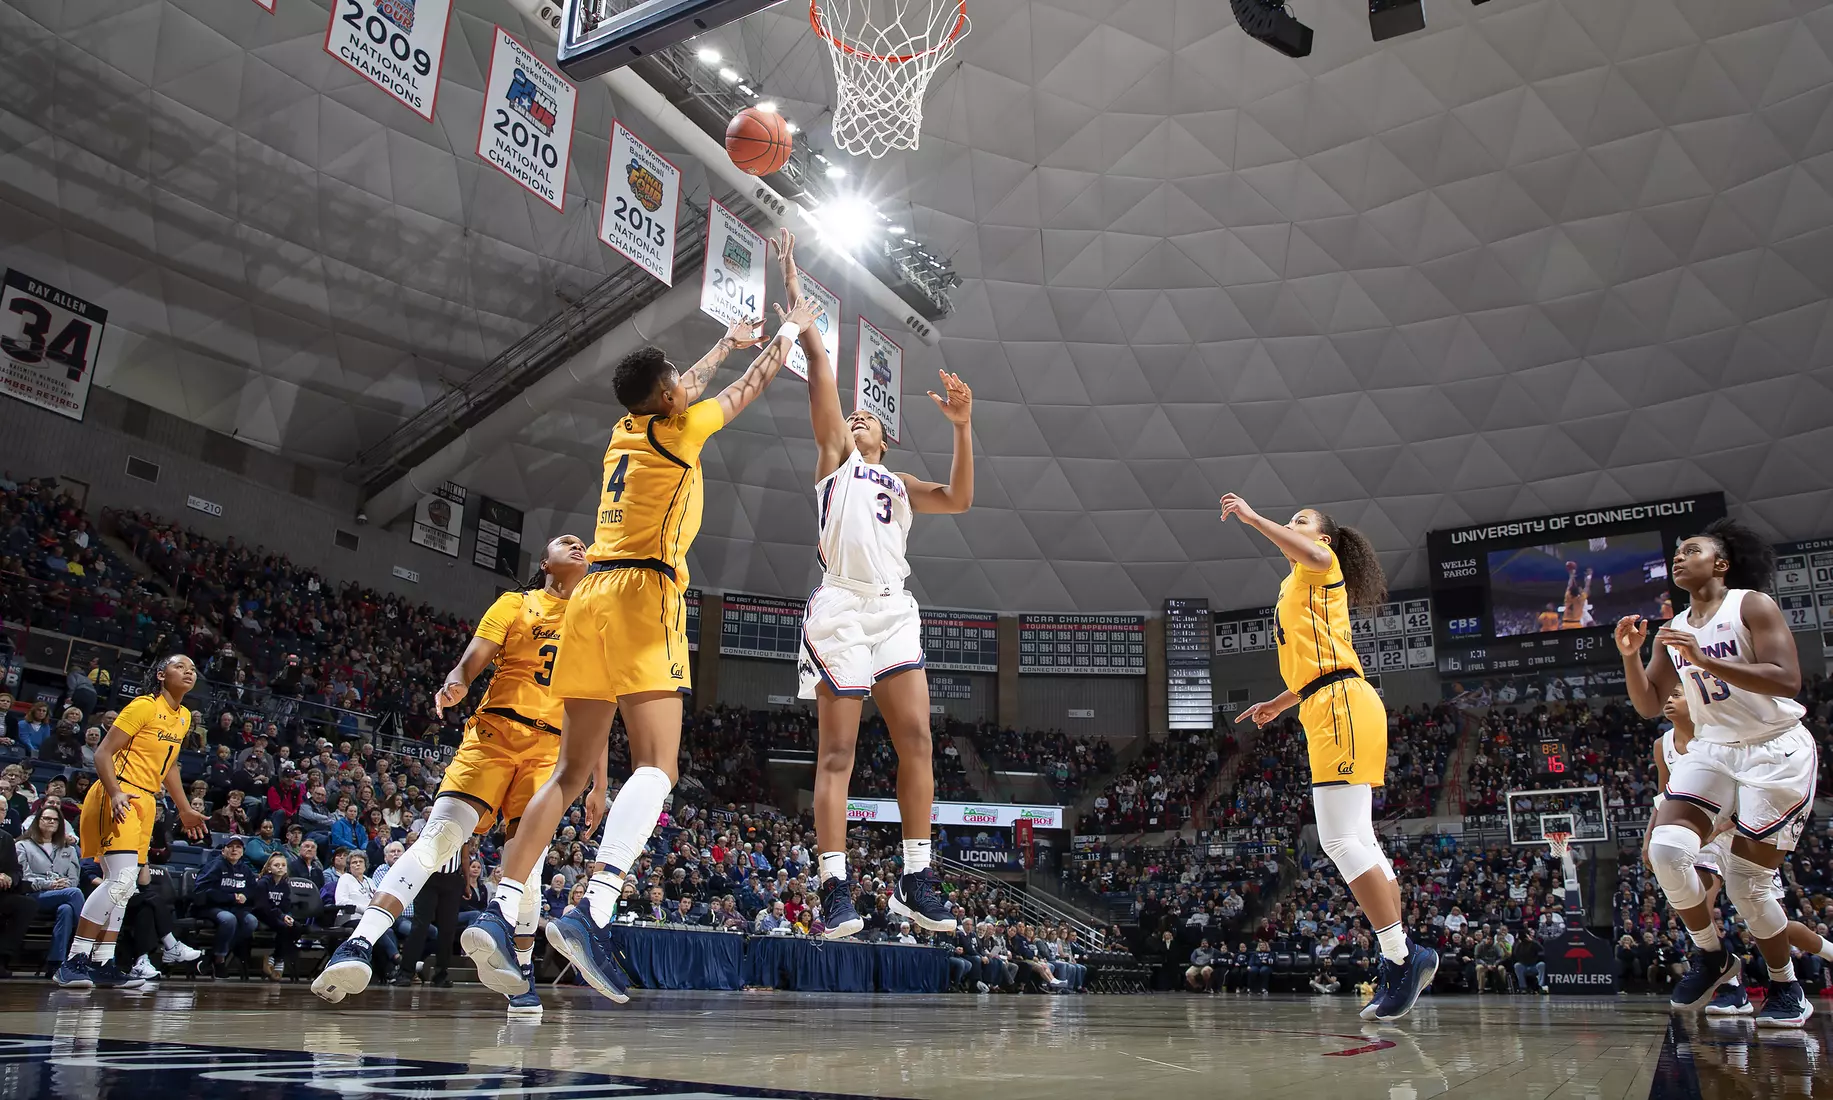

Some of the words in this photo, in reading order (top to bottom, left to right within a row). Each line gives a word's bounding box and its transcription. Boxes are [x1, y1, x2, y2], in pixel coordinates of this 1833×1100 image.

[342, 0, 431, 76] 2009
[349, 33, 418, 90] NATIONAL
[504, 35, 532, 63] UConn
[534, 58, 570, 93] Women's
[340, 46, 421, 108] CHAMPIONS
[515, 56, 557, 94] Basketball
[494, 109, 558, 169] 2010
[619, 127, 643, 151] UConn
[644, 145, 675, 176] Women's
[495, 137, 551, 184] NATIONAL
[629, 146, 664, 178] Basketball
[488, 149, 554, 200] CHAMPIONS
[613, 196, 665, 247] 2013
[716, 205, 736, 224] UConn
[614, 221, 661, 261] NATIONAL
[724, 221, 754, 249] Basketball
[608, 233, 664, 276] CHAMPIONS
[28, 281, 50, 298] RAY
[53, 292, 87, 314] ALLEN
[712, 268, 756, 313] 2014
[0, 297, 92, 383] 34
[36, 389, 79, 410] RETIRED
[862, 378, 896, 414] 2016
[863, 399, 893, 425] NATIONAL
[606, 454, 629, 503] 4
[854, 465, 906, 500] UCONN
[203, 502, 221, 514] 210
[876, 492, 892, 525] 3
[600, 509, 624, 524] STYLES
[1451, 519, 1544, 544] UNIVERSITY
[1549, 515, 1570, 530] OF
[1575, 500, 1696, 527] CONNECTICUT
[1797, 540, 1833, 550] UCONN
[1441, 558, 1477, 570] WELLS
[407, 571, 419, 581] 211
[1443, 567, 1477, 579] FARGO
[736, 603, 789, 614] TOURNAMENT
[758, 599, 787, 607] AMERICAN
[1026, 615, 1054, 623] NCAA
[1059, 616, 1138, 624] CHAMPIONSHIP
[1408, 613, 1428, 628] 42
[1448, 617, 1478, 629] CBS
[1791, 609, 1807, 624] 22
[1352, 620, 1371, 633] 44
[963, 641, 978, 650] 2015
[1221, 636, 1233, 648] C
[1249, 633, 1257, 645] 9
[1576, 636, 1603, 650] 8:21
[723, 648, 773, 657] CONNECTICUT
[1383, 652, 1402, 665] 22
[1534, 656, 1544, 664] TM
[1544, 655, 1556, 663] FLS
[533, 644, 558, 687] 3
[670, 662, 684, 679] Cal
[1471, 662, 1485, 671] FULL
[1507, 659, 1520, 668] SEC
[121, 684, 142, 695] SEC
[1690, 670, 1731, 705] 13
[402, 745, 416, 755] SEC
[418, 747, 440, 761] 109
[1541, 743, 1566, 755] 8:21
[160, 745, 174, 776] 1
[1337, 761, 1354, 776] Cal
[1547, 755, 1565, 773] 16
[960, 850, 1008, 863] UCONN
[1262, 846, 1277, 854] 113
[290, 881, 313, 889] UCONN
[1547, 973, 1613, 984] TRAVELERS
